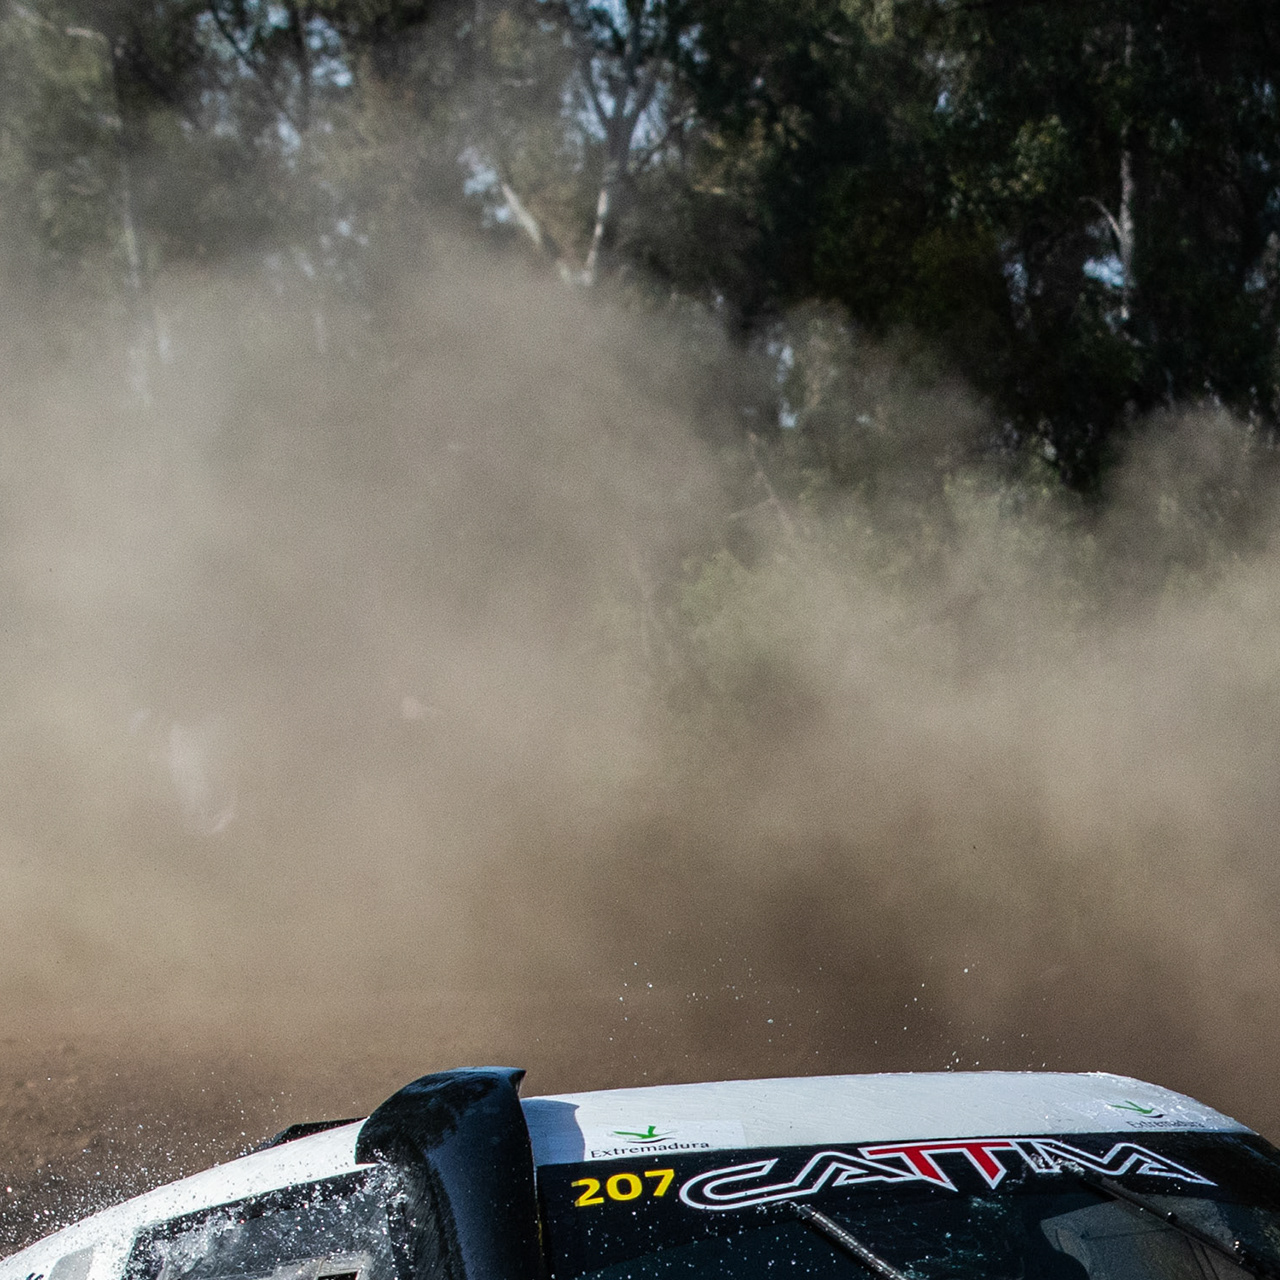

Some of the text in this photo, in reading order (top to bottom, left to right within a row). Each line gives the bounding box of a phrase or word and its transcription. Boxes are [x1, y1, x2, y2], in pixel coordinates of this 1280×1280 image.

[590, 1140, 710, 1159] Extremadura
[571, 1168, 676, 1208] 207
[679, 1137, 1219, 1211] CATTIVA
